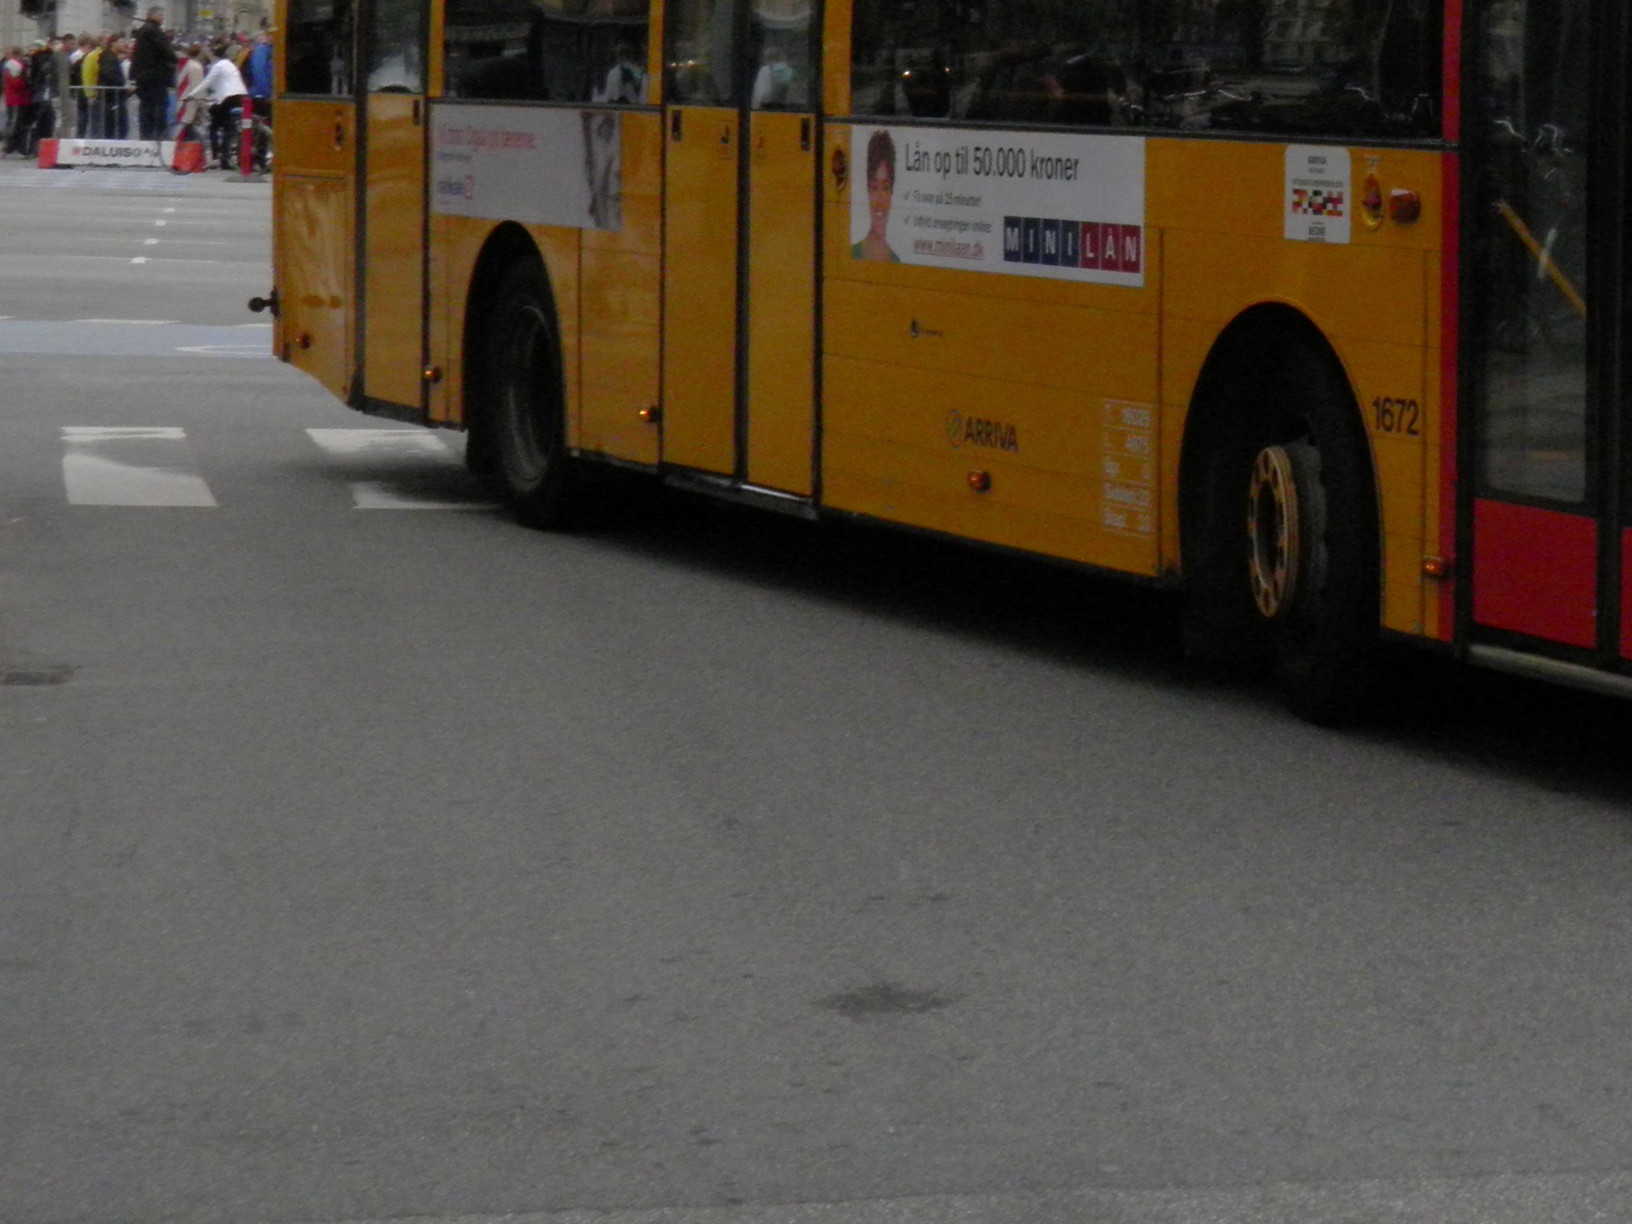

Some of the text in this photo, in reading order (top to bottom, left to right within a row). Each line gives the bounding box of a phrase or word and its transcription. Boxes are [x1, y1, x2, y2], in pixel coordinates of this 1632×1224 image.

[905, 142, 1080, 182] Lån op til 50.000 kroner
[964, 416, 1021, 453] ARRIVA
[1371, 396, 1421, 437] 1672
